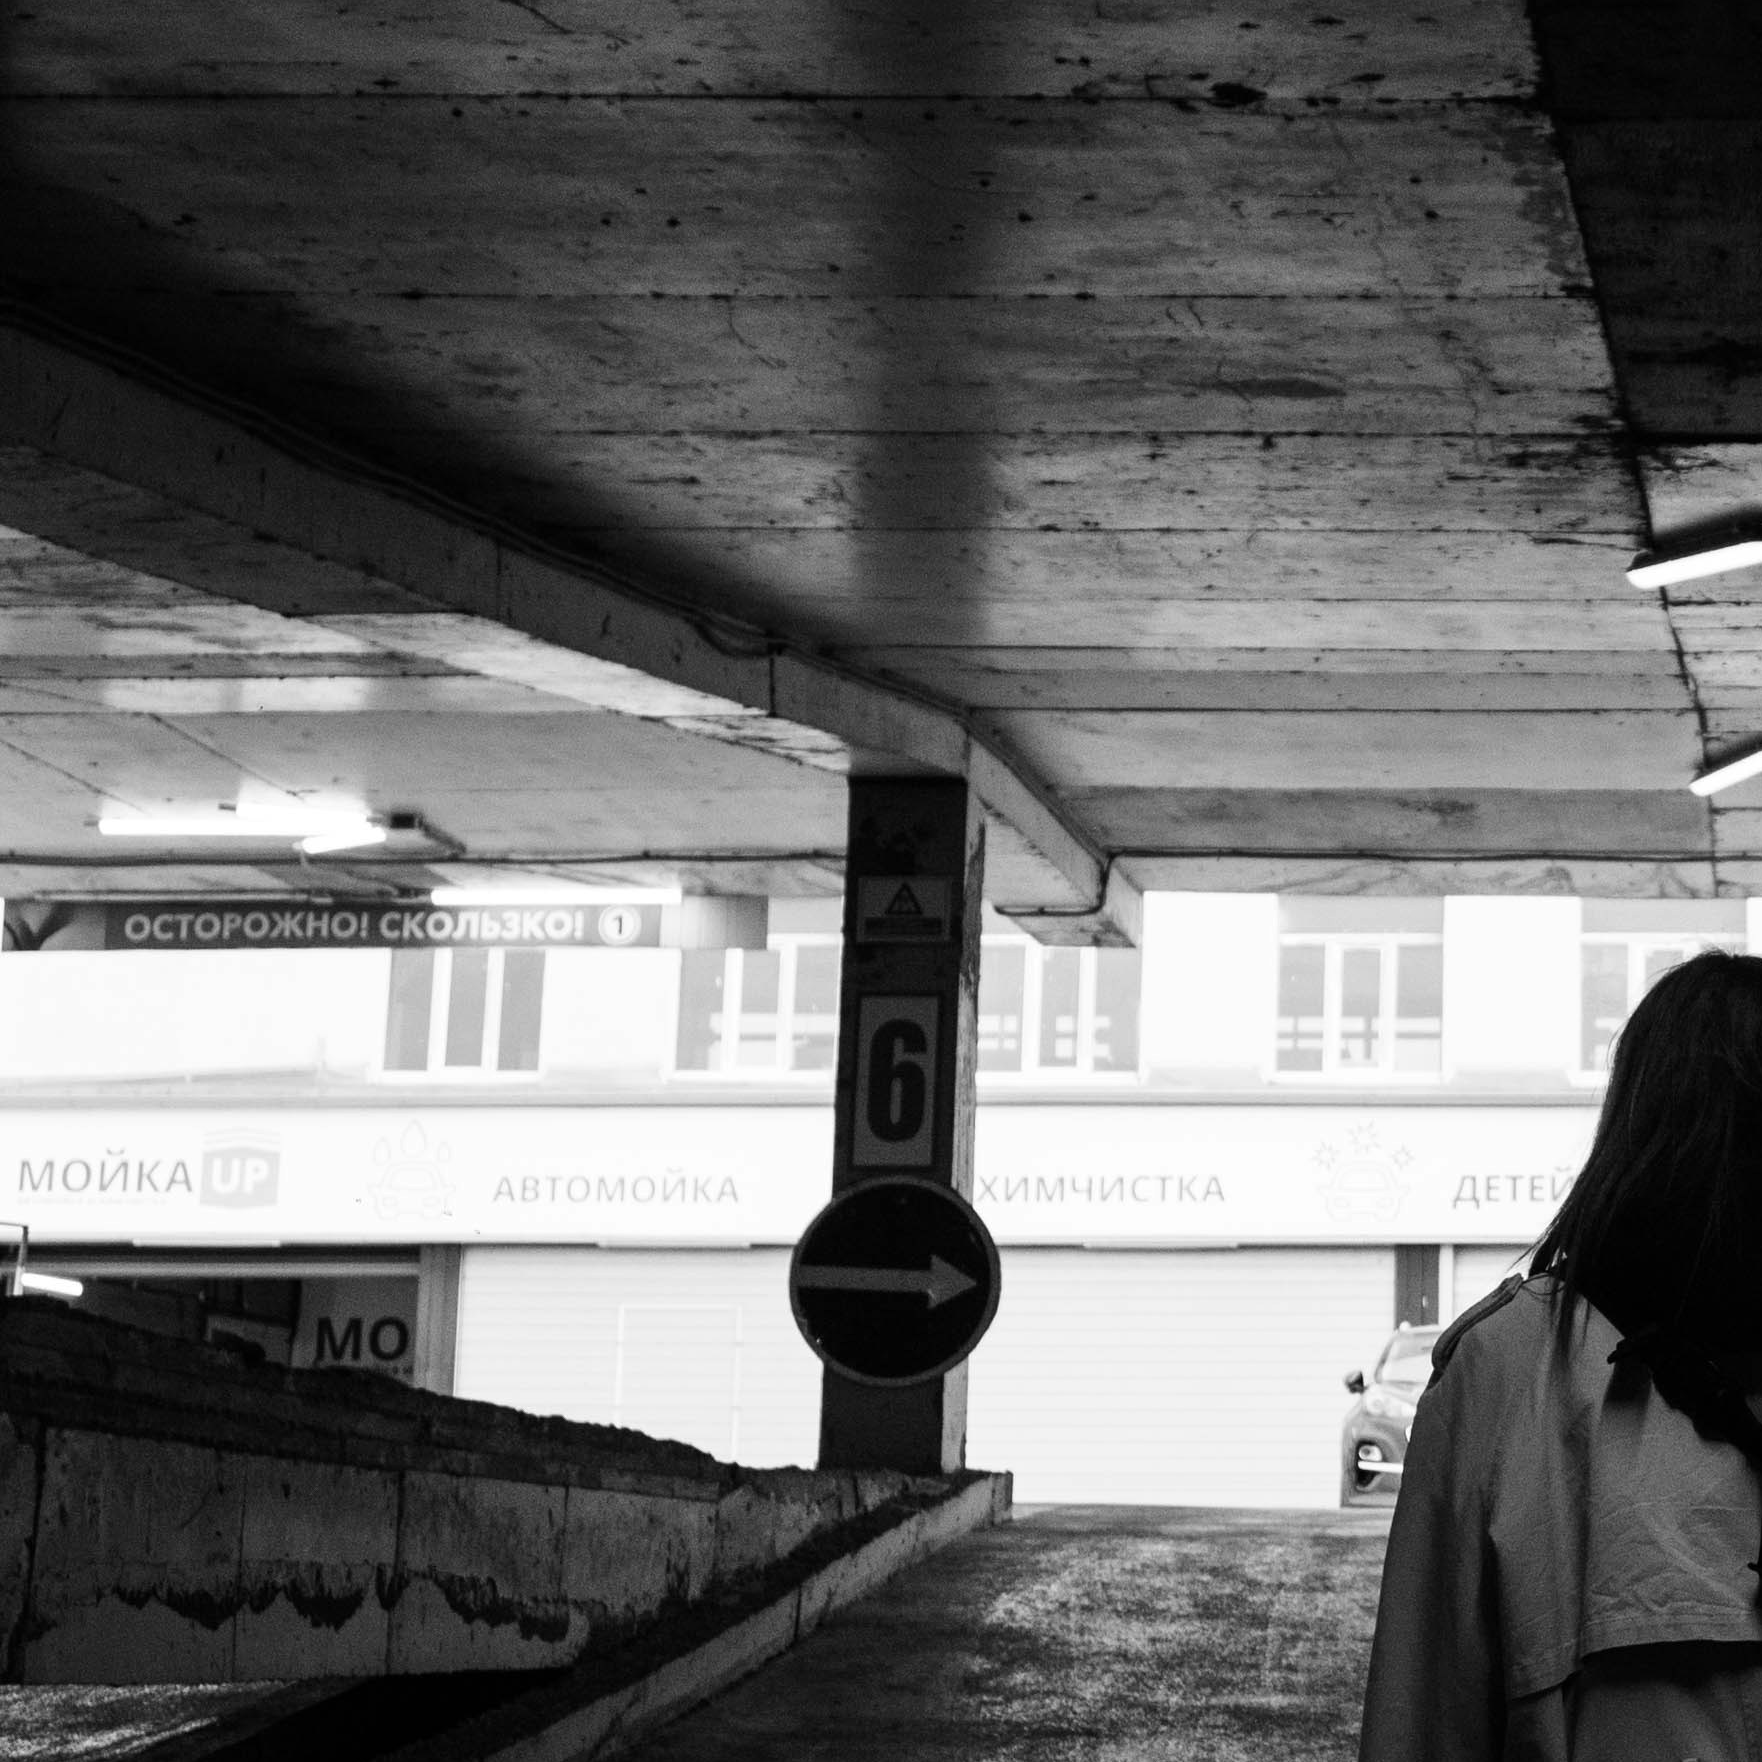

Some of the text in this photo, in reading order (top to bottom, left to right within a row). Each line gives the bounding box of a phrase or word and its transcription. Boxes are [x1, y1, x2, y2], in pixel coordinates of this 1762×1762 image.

[124, 908, 585, 942] ОСТОРОЖНО! СКОЛЬЗКО!
[867, 1017, 928, 1144] 6
[17, 1146, 269, 1195] МОЙКА UP
[492, 1166, 740, 1204] АВТОМОЙКА
[977, 1174, 1226, 1204] ХИМЧИСТКА
